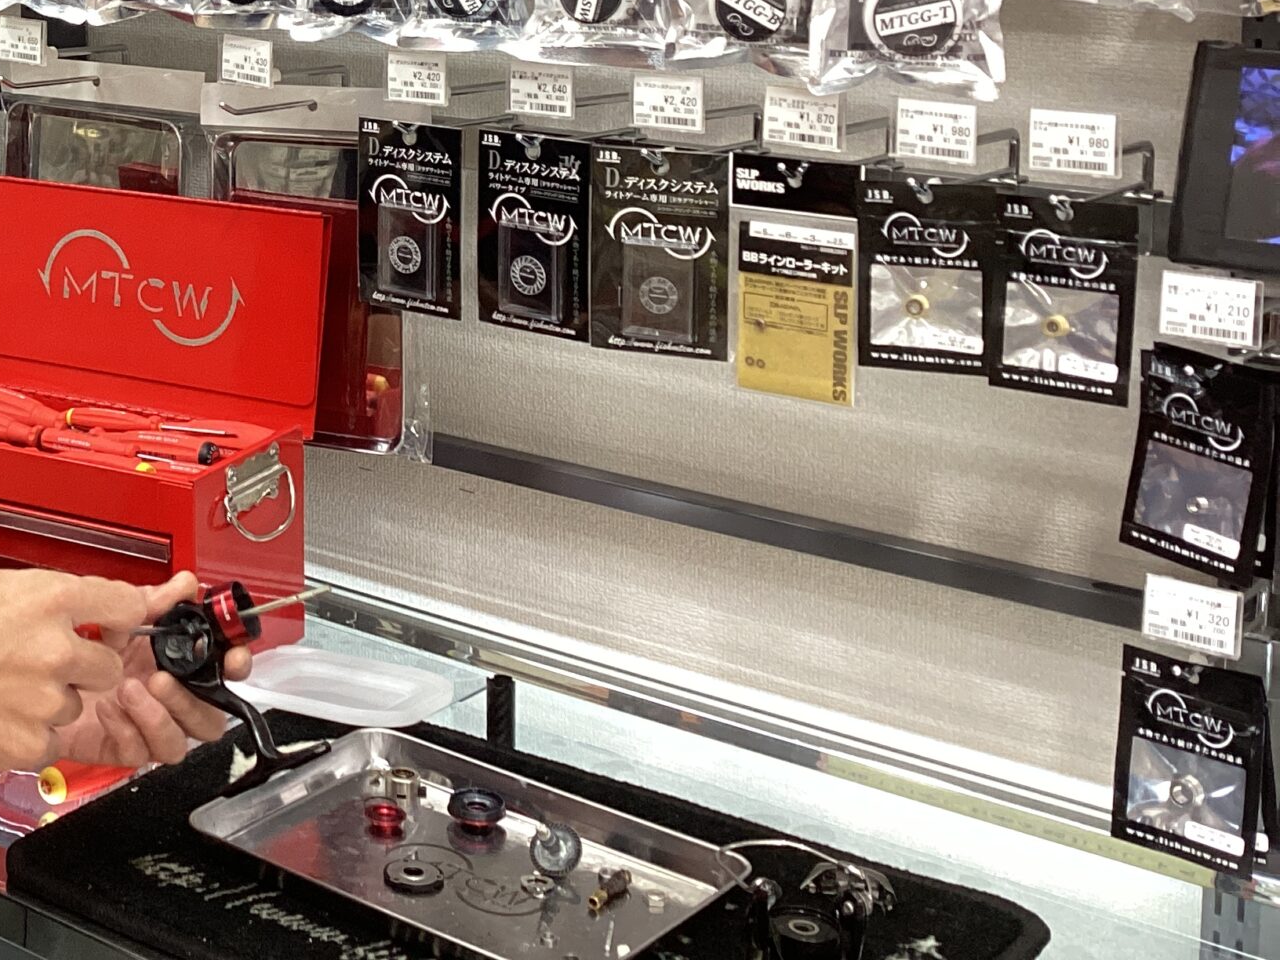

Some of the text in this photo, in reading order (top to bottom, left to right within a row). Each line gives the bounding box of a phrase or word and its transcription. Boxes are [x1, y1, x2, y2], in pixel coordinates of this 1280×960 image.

[879, 4, 953, 33] MTGG-T
[736, 167, 760, 179] SLP
[736, 178, 786, 194] WORKS
[488, 182, 527, 195] パワータイプ
[891, 226, 958, 243] MTCW
[742, 250, 849, 277] BBラインローラーキット
[1028, 242, 1097, 264] MTCW
[63, 266, 214, 321] MTCW
[832, 290, 849, 403] SLP WORKS
[871, 350, 983, 368] www.fishmtcw.com
[1001, 371, 1114, 397] www.fishmtcw.com
[1170, 406, 1232, 437] MTCW
[1156, 701, 1225, 734] MTCW
